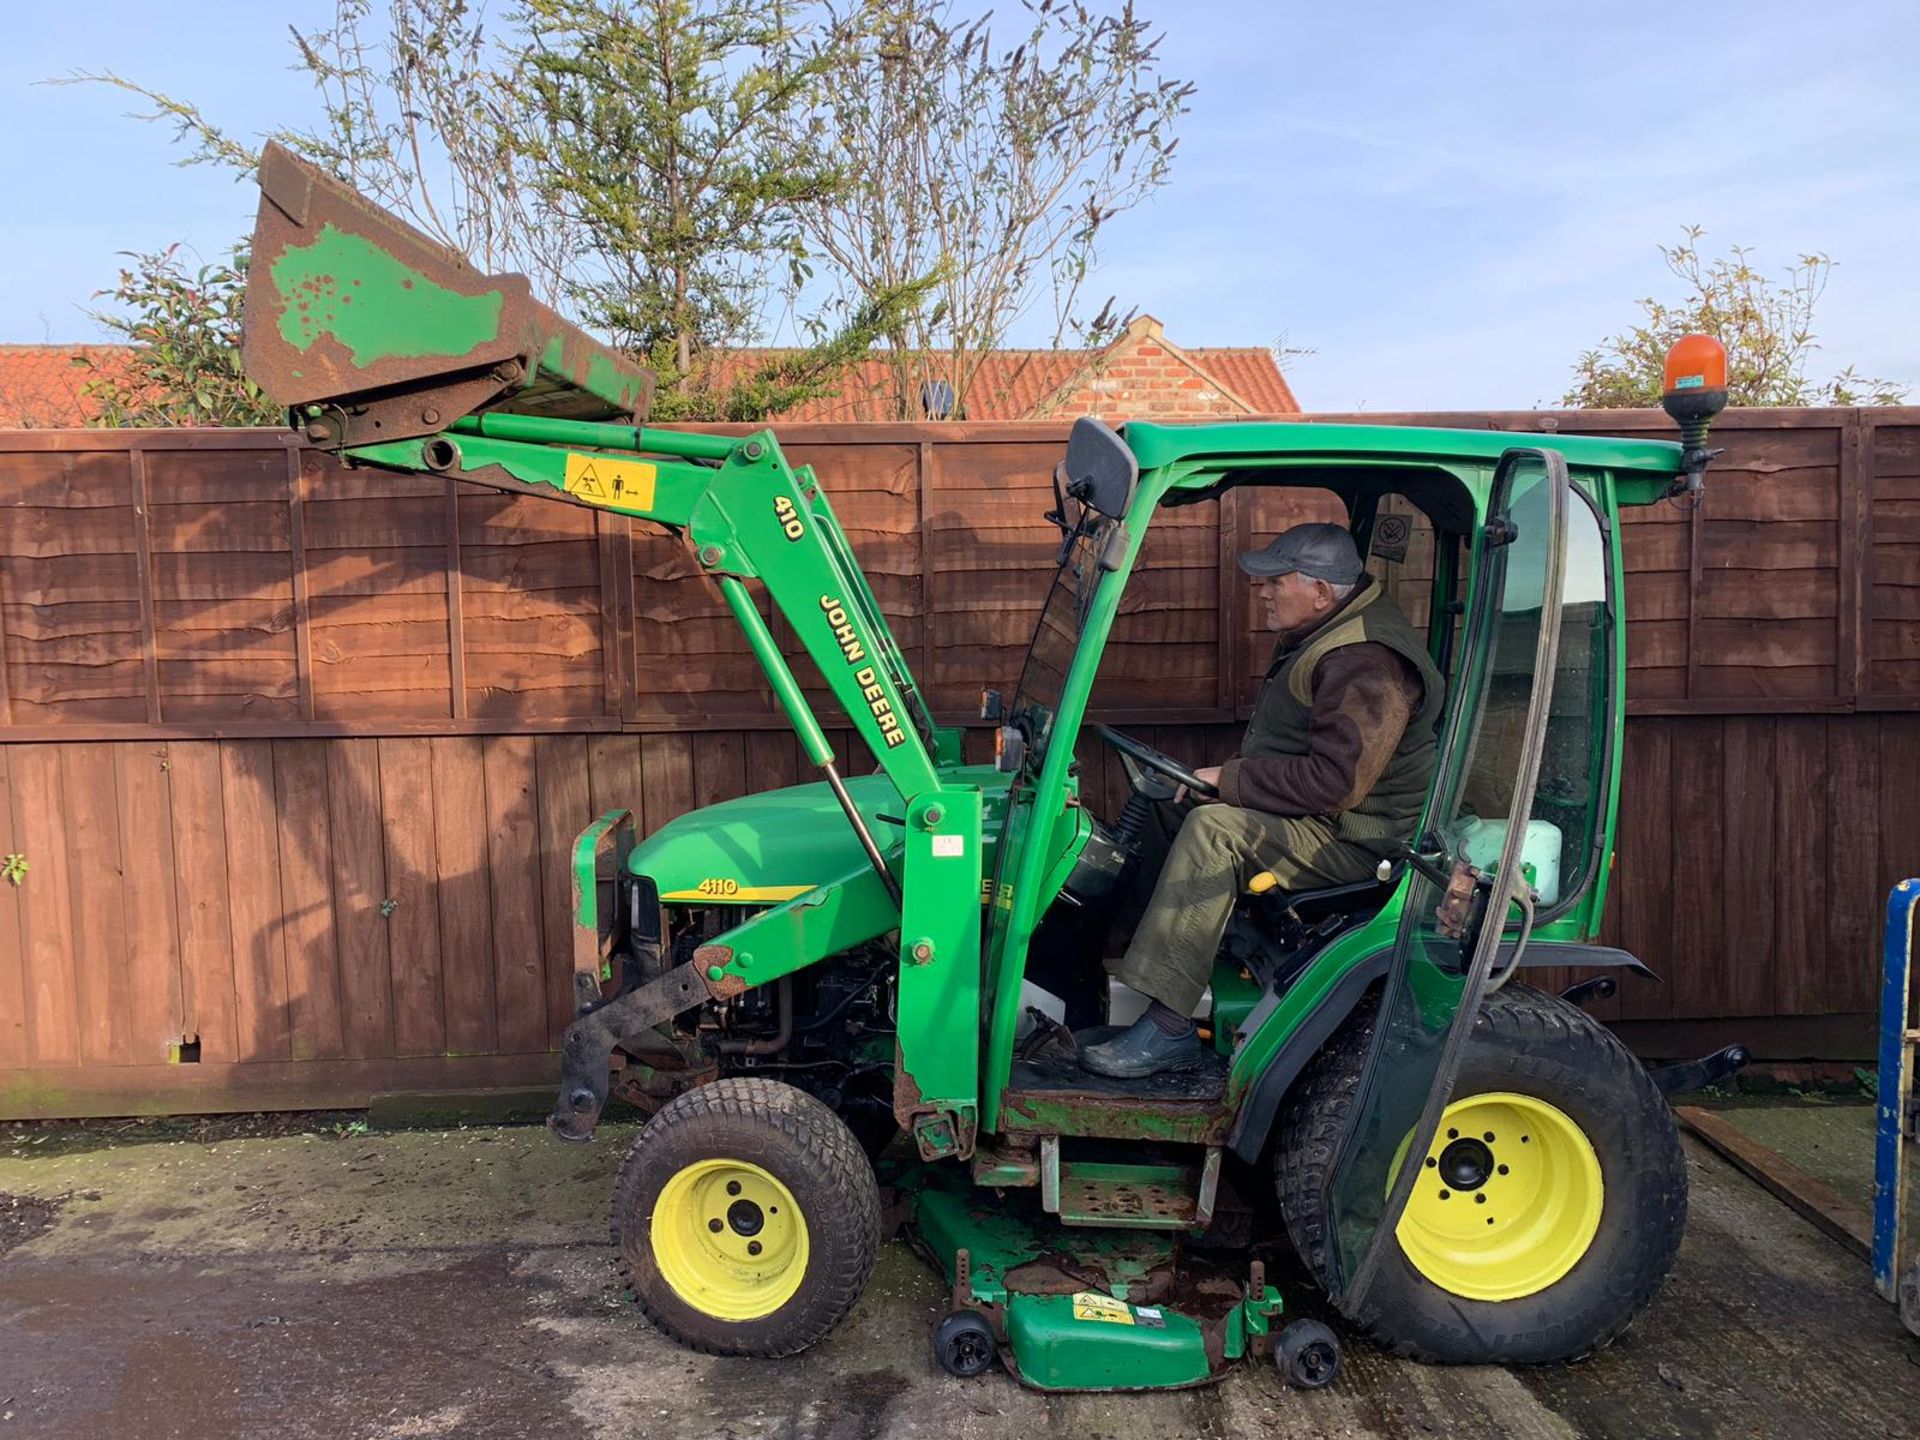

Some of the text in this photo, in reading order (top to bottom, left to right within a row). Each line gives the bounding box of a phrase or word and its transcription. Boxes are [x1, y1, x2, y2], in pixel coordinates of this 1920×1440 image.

[774, 495, 804, 541] 410
[820, 595, 906, 749] JOHN DEERE
[698, 878, 738, 894] 4110
